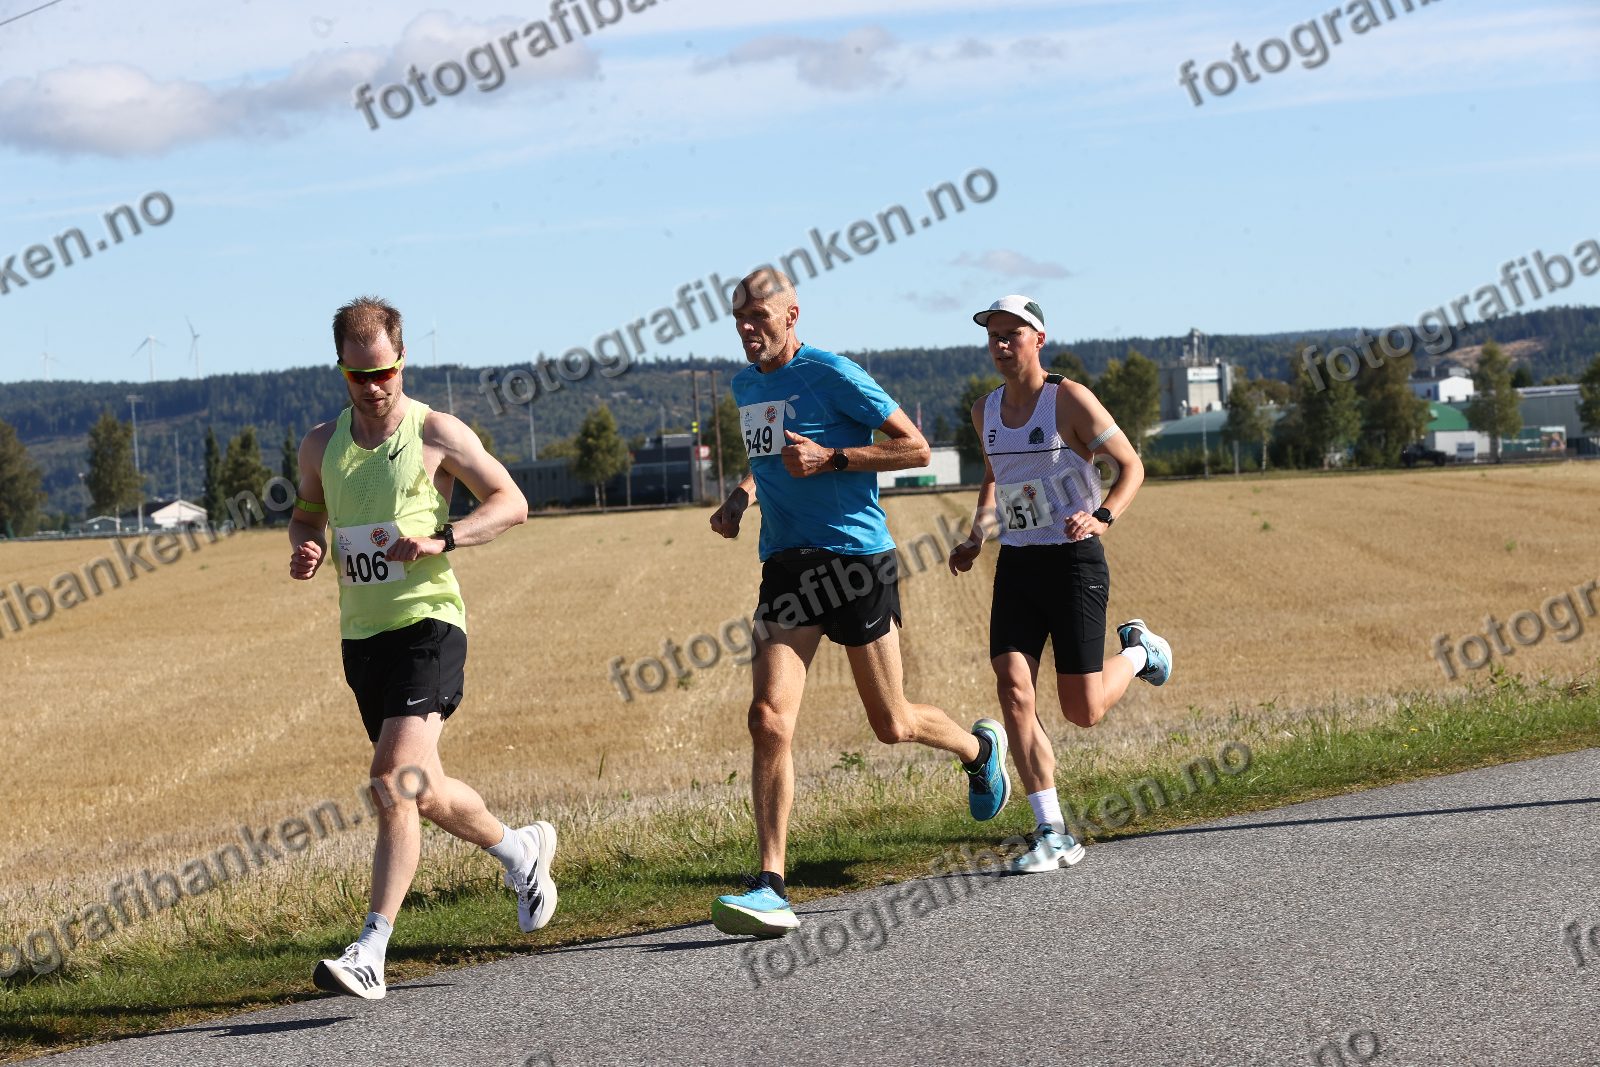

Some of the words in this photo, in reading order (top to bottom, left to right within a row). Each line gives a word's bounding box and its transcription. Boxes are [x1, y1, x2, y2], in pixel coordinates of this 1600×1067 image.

[745, 426, 773, 454] 549
[1006, 503, 1038, 530] 251
[346, 551, 389, 583] 406
